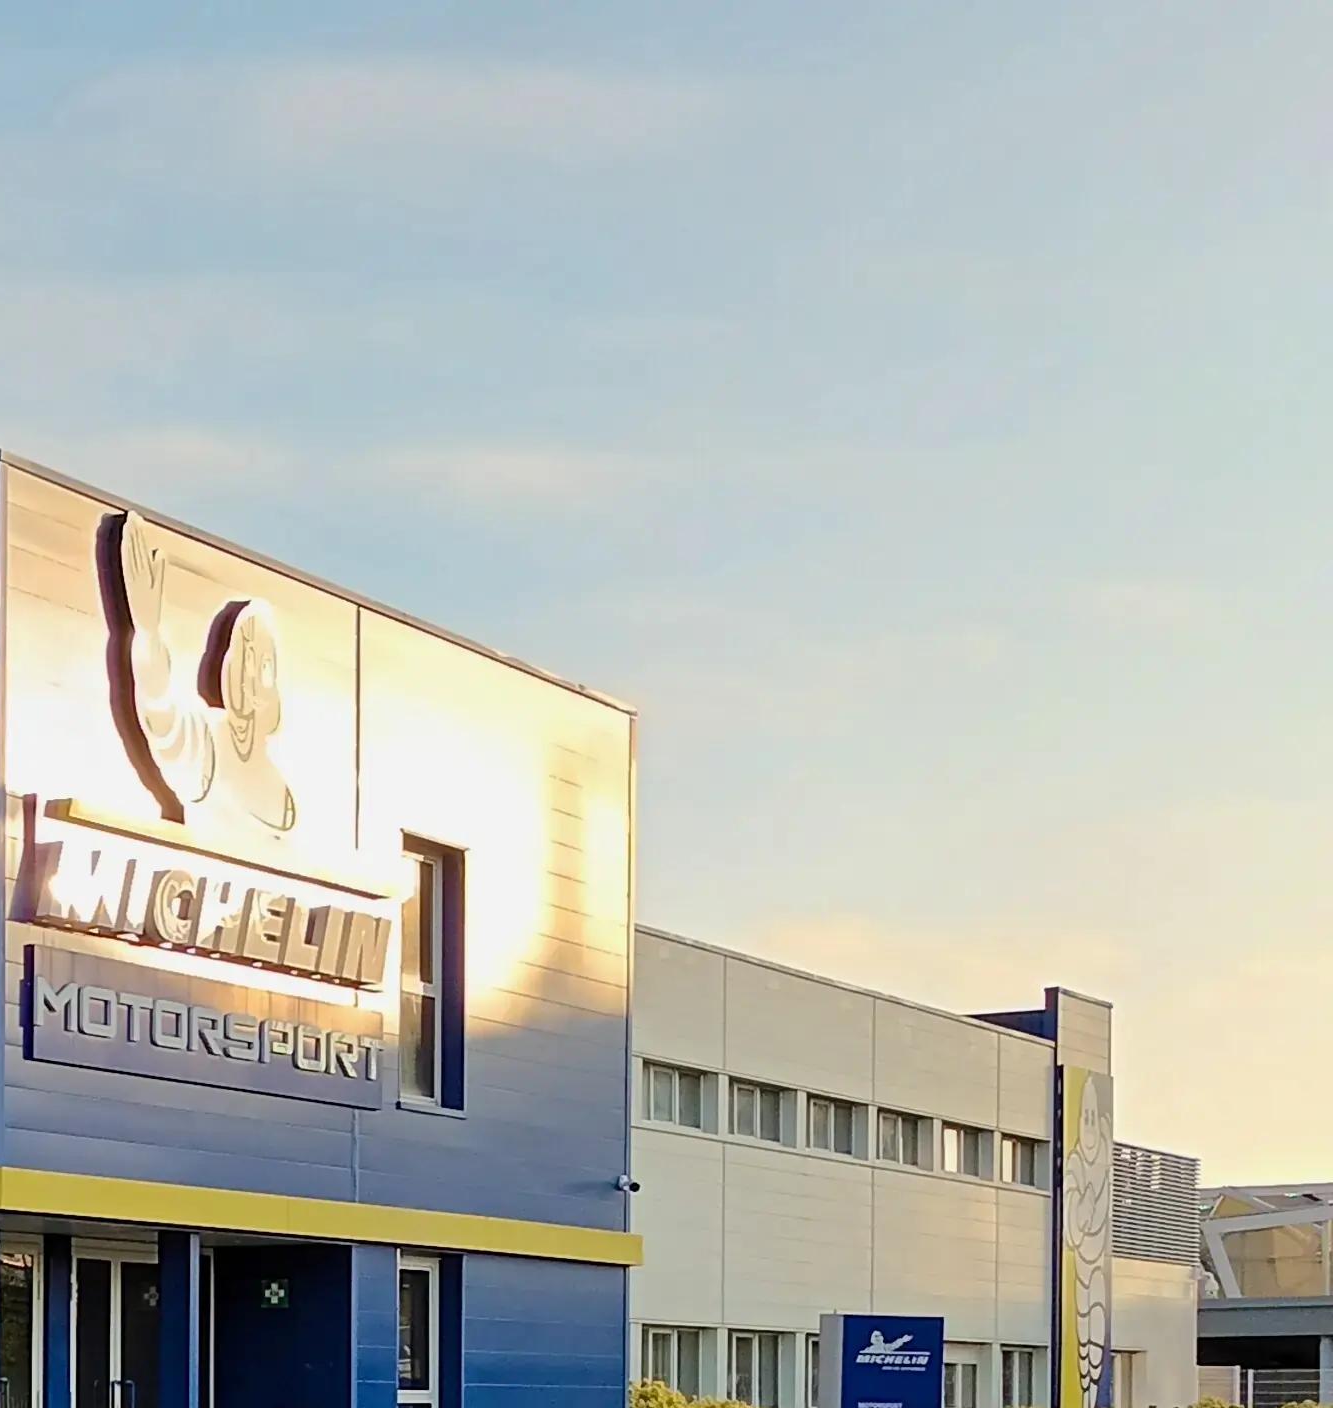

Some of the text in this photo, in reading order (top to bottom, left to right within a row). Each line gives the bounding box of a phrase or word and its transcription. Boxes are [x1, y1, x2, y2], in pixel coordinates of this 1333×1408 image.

[17, 838, 392, 985] MICHELIN
[32, 975, 384, 1081] MOTORSPORT
[856, 1355, 929, 1365] MICHELIN
